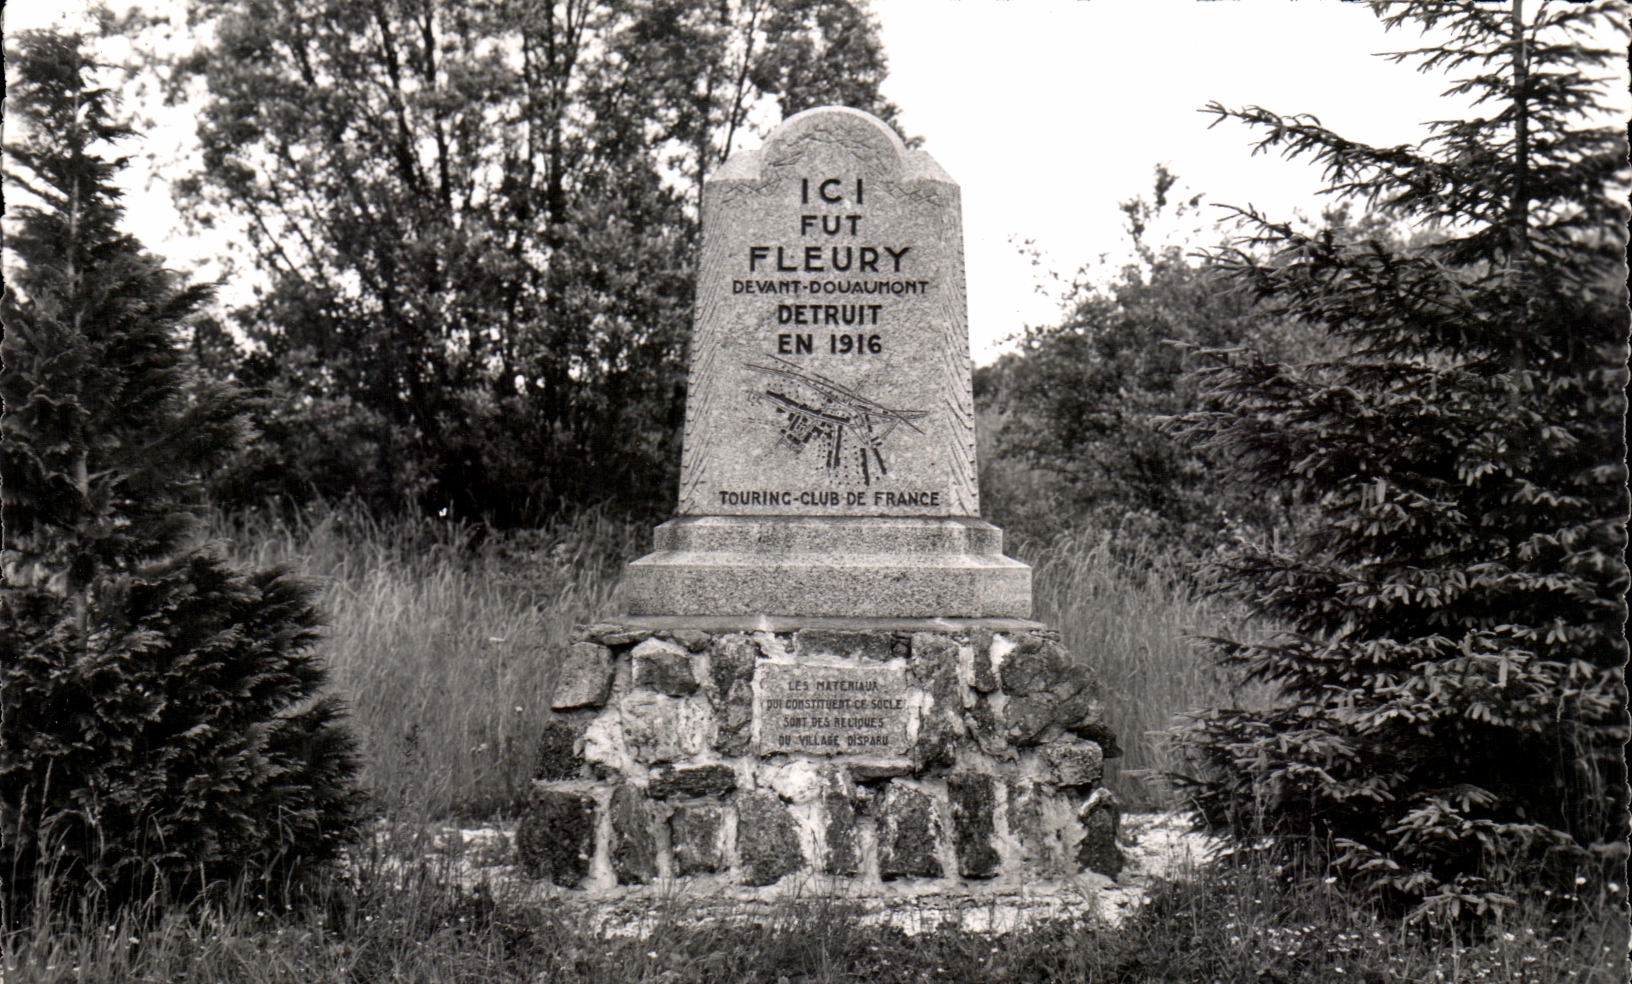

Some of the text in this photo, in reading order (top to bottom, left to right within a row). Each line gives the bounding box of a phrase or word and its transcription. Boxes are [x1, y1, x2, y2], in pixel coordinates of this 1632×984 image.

[802, 178, 863, 204] ICI
[801, 215, 862, 236] FUT
[750, 246, 912, 272] FLEURY
[732, 280, 929, 294] DEVANT-DOUAUMONT
[778, 304, 882, 325] DETRUIT
[778, 334, 882, 354] EN 1916
[719, 491, 940, 506] TOURING-CLUB DE FRANCE
[788, 681, 809, 691] LES
[785, 699, 850, 709] CONSTITUENT
[854, 699, 868, 709] CE
[871, 699, 903, 710] SOCLE
[784, 717, 884, 729] SONT DES RELIQUES
[778, 735, 888, 746] DU VILLAGE DISPARU
